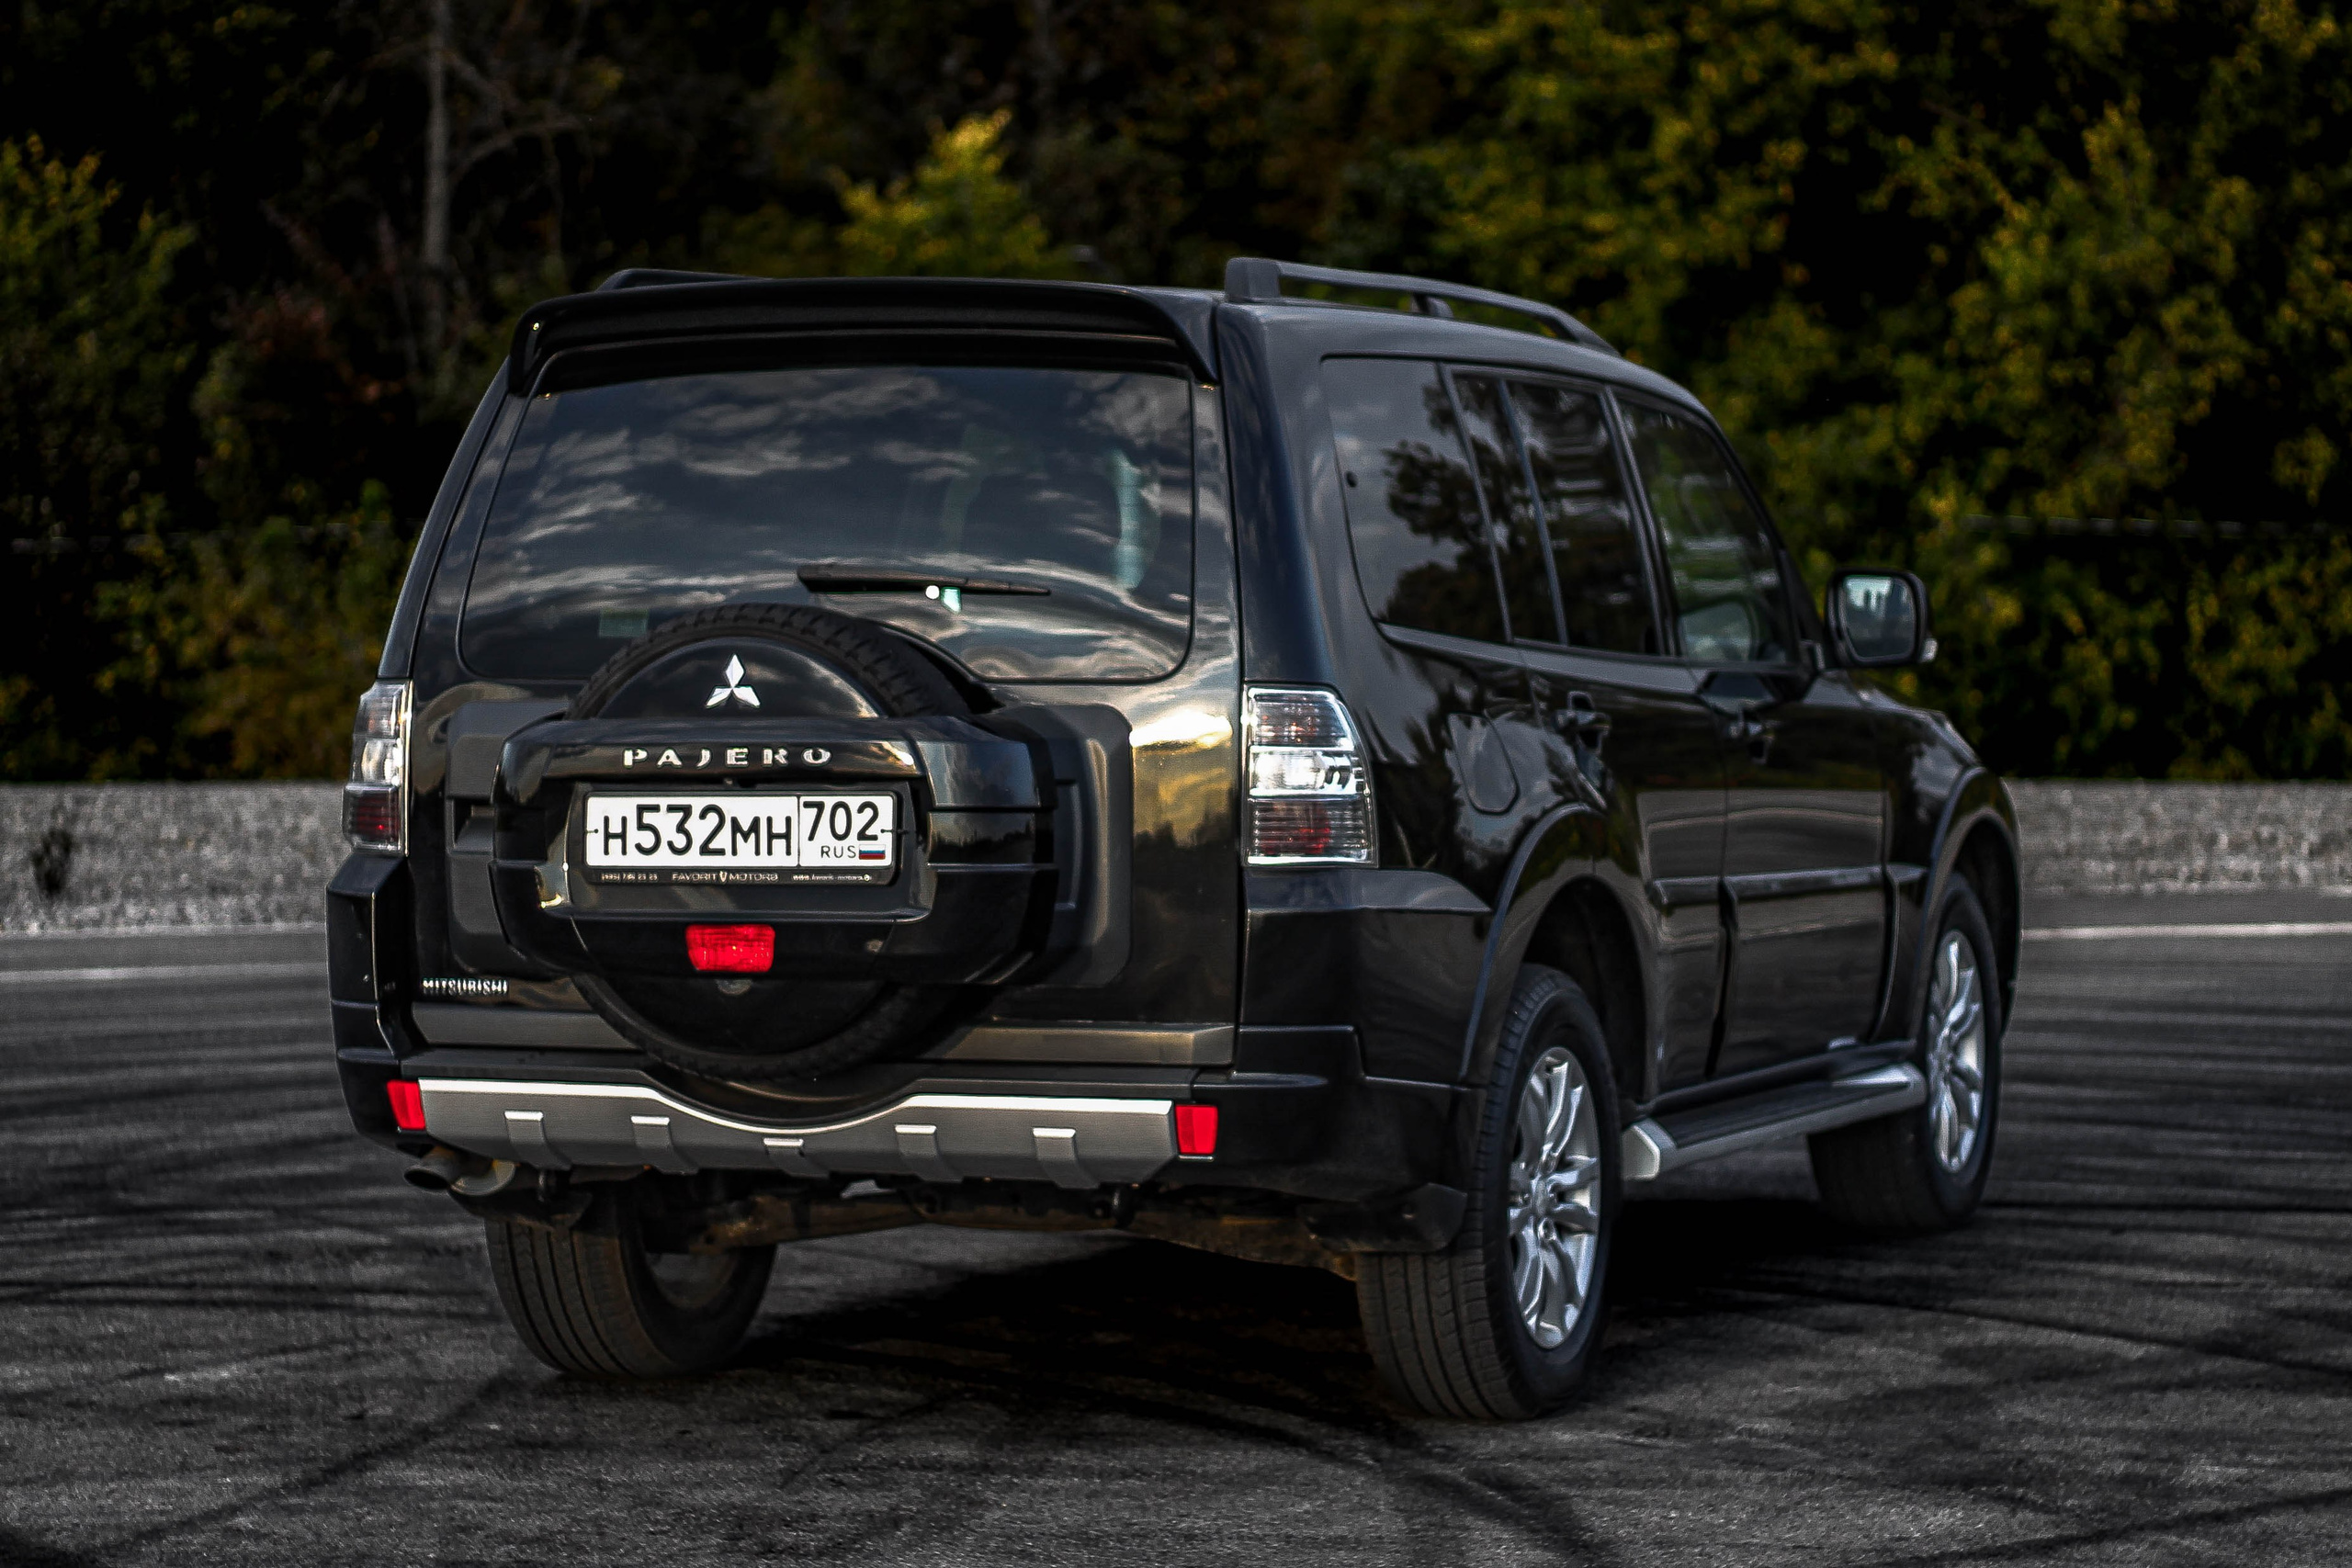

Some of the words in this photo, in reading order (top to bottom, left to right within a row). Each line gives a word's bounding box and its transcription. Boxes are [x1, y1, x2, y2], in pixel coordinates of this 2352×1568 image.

[623, 747, 831, 768] PAJERO
[802, 800, 879, 841] 702
[820, 845, 856, 859] RUS
[672, 873, 717, 881] FAVORIT
[729, 872, 779, 882] MOTORS
[423, 977, 508, 995] MITSUBISHI
